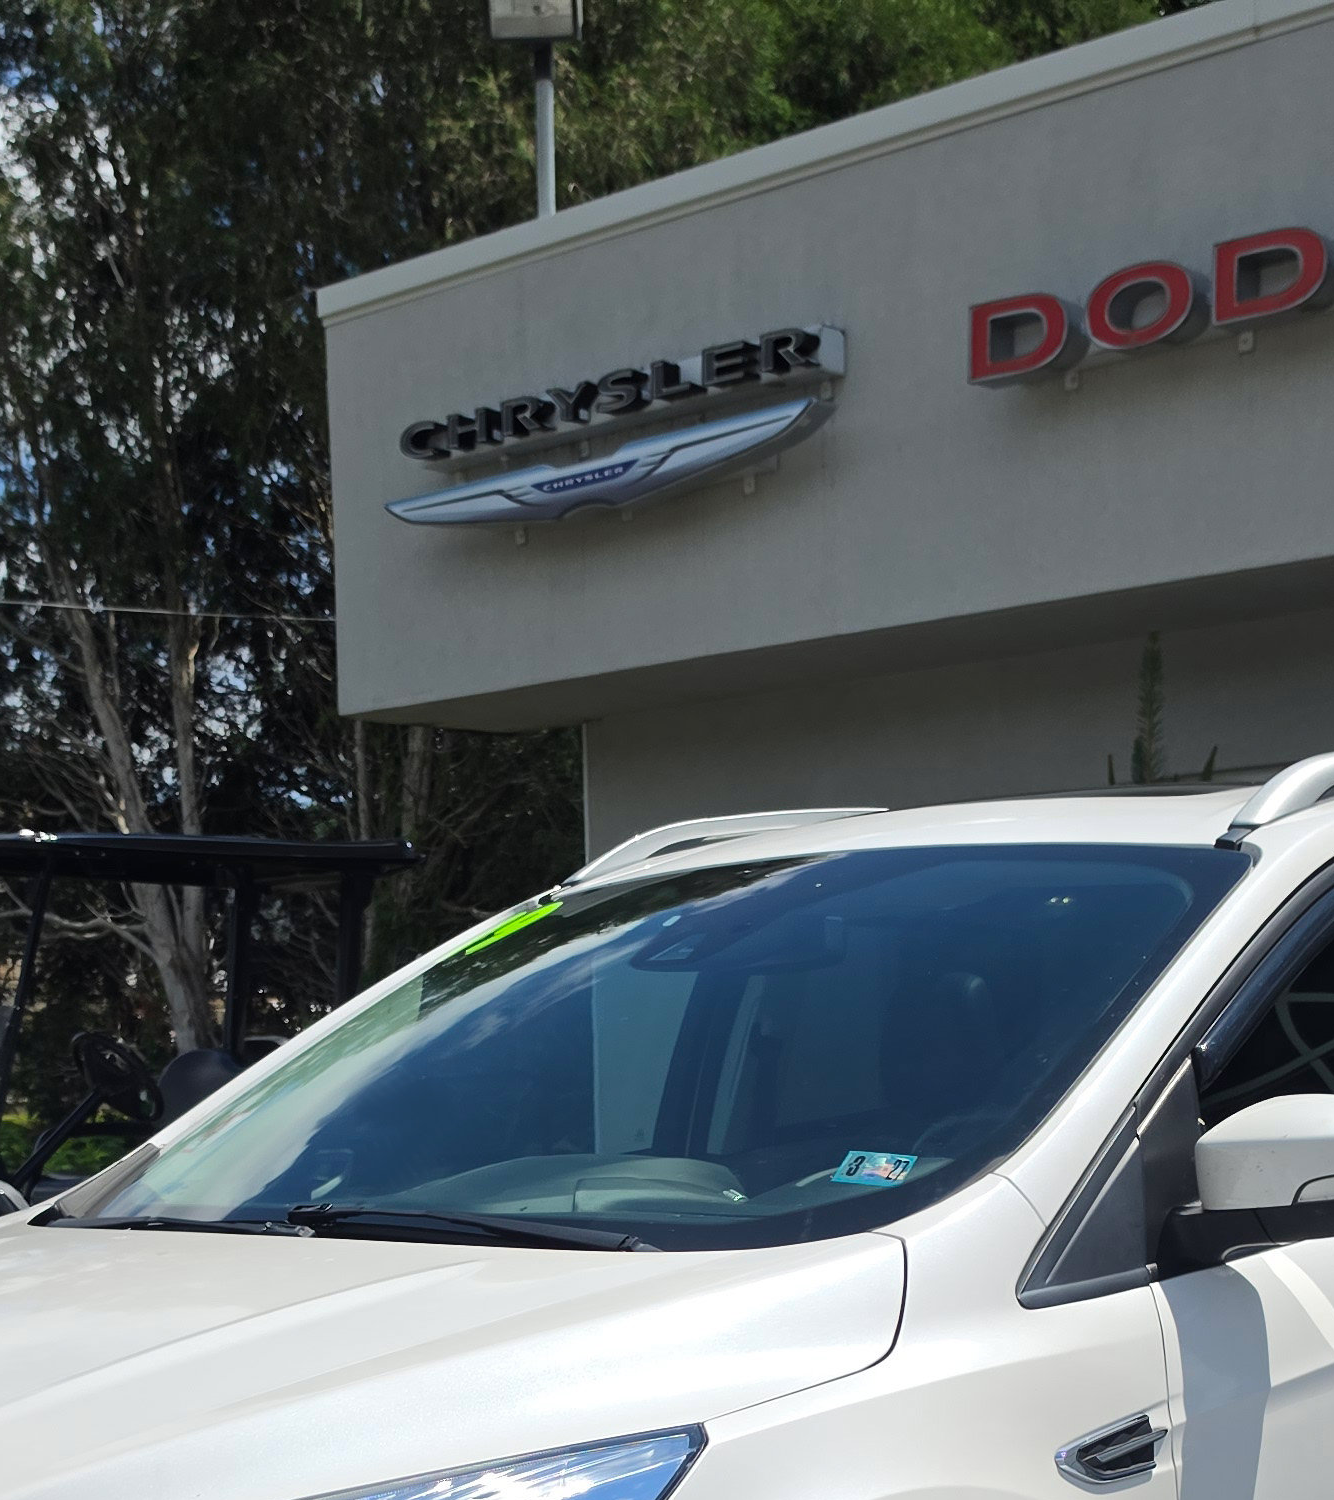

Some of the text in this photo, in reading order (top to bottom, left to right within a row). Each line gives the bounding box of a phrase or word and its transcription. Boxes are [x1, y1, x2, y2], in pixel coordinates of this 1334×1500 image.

[399, 327, 821, 461] CHRYSLER
[542, 465, 624, 493] CHRYSLER
[846, 1155, 910, 1182] 3 27
